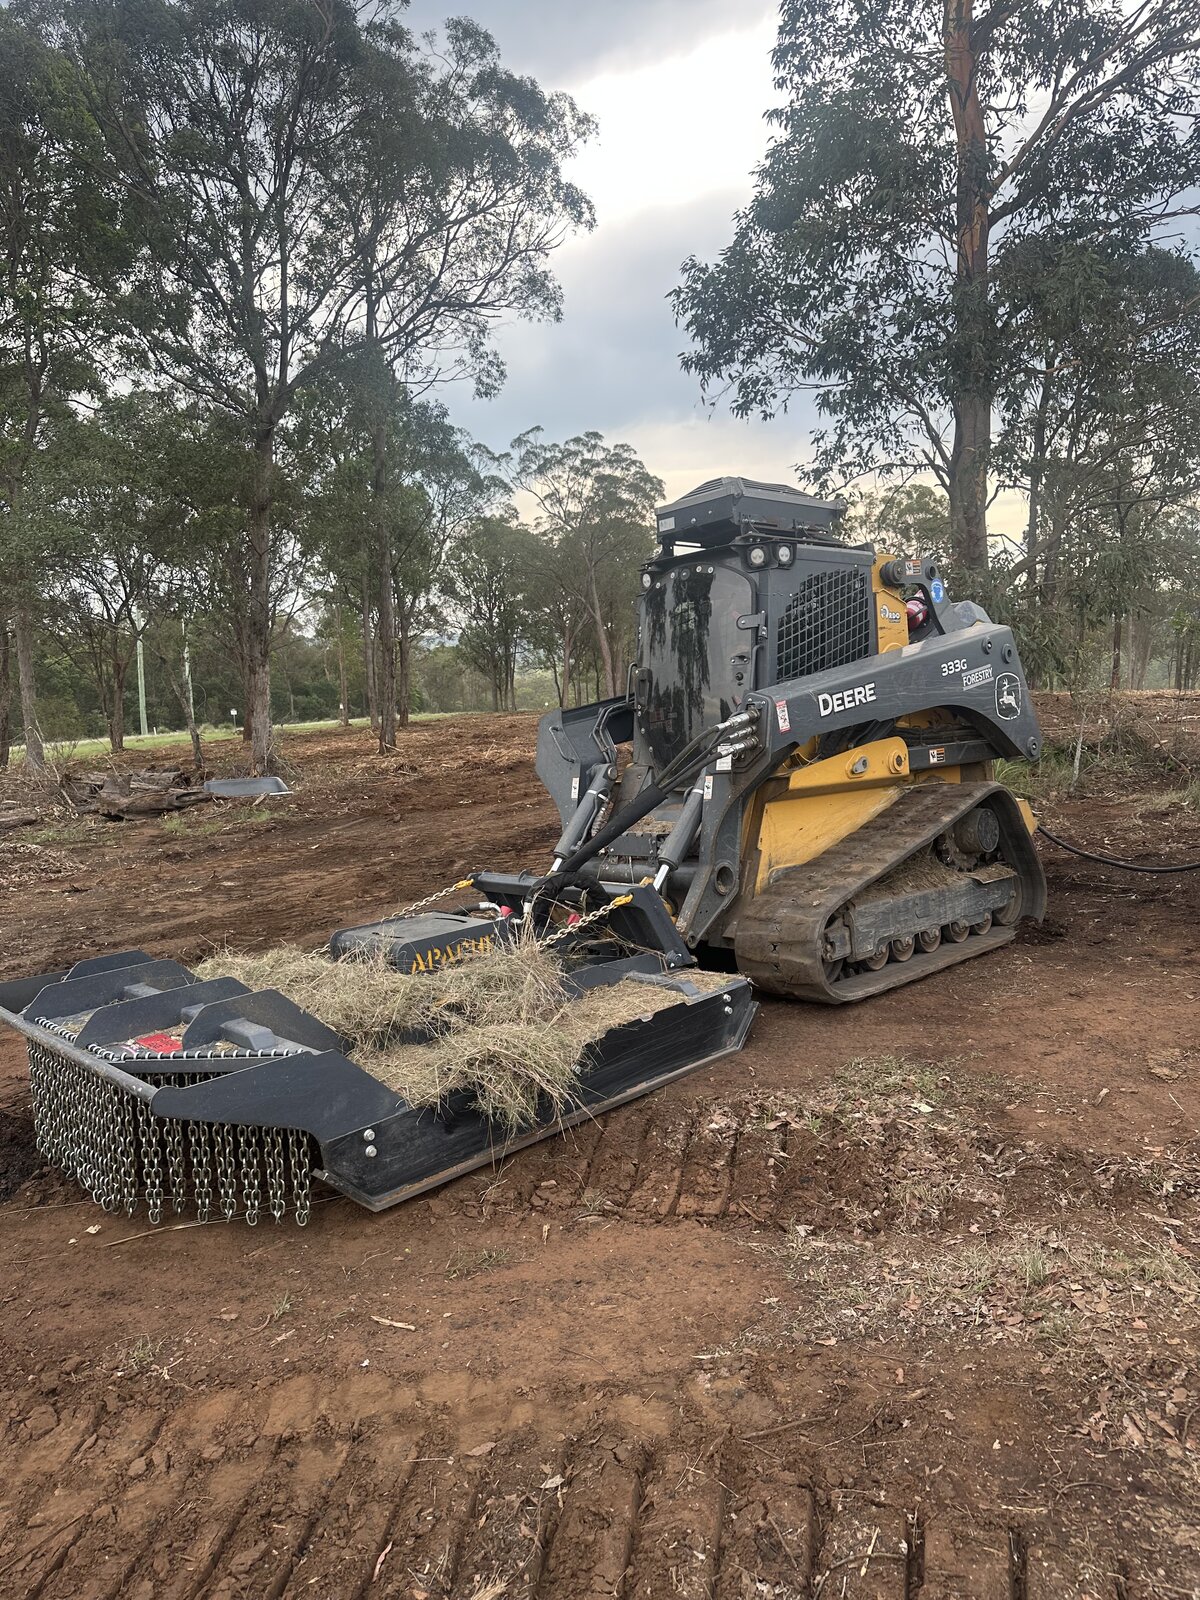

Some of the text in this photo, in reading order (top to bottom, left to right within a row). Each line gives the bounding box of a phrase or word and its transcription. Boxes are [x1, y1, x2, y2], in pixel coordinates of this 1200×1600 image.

[940, 658, 967, 677] 333G
[962, 667, 993, 687] FORESTRY
[817, 682, 877, 717] DEERE
